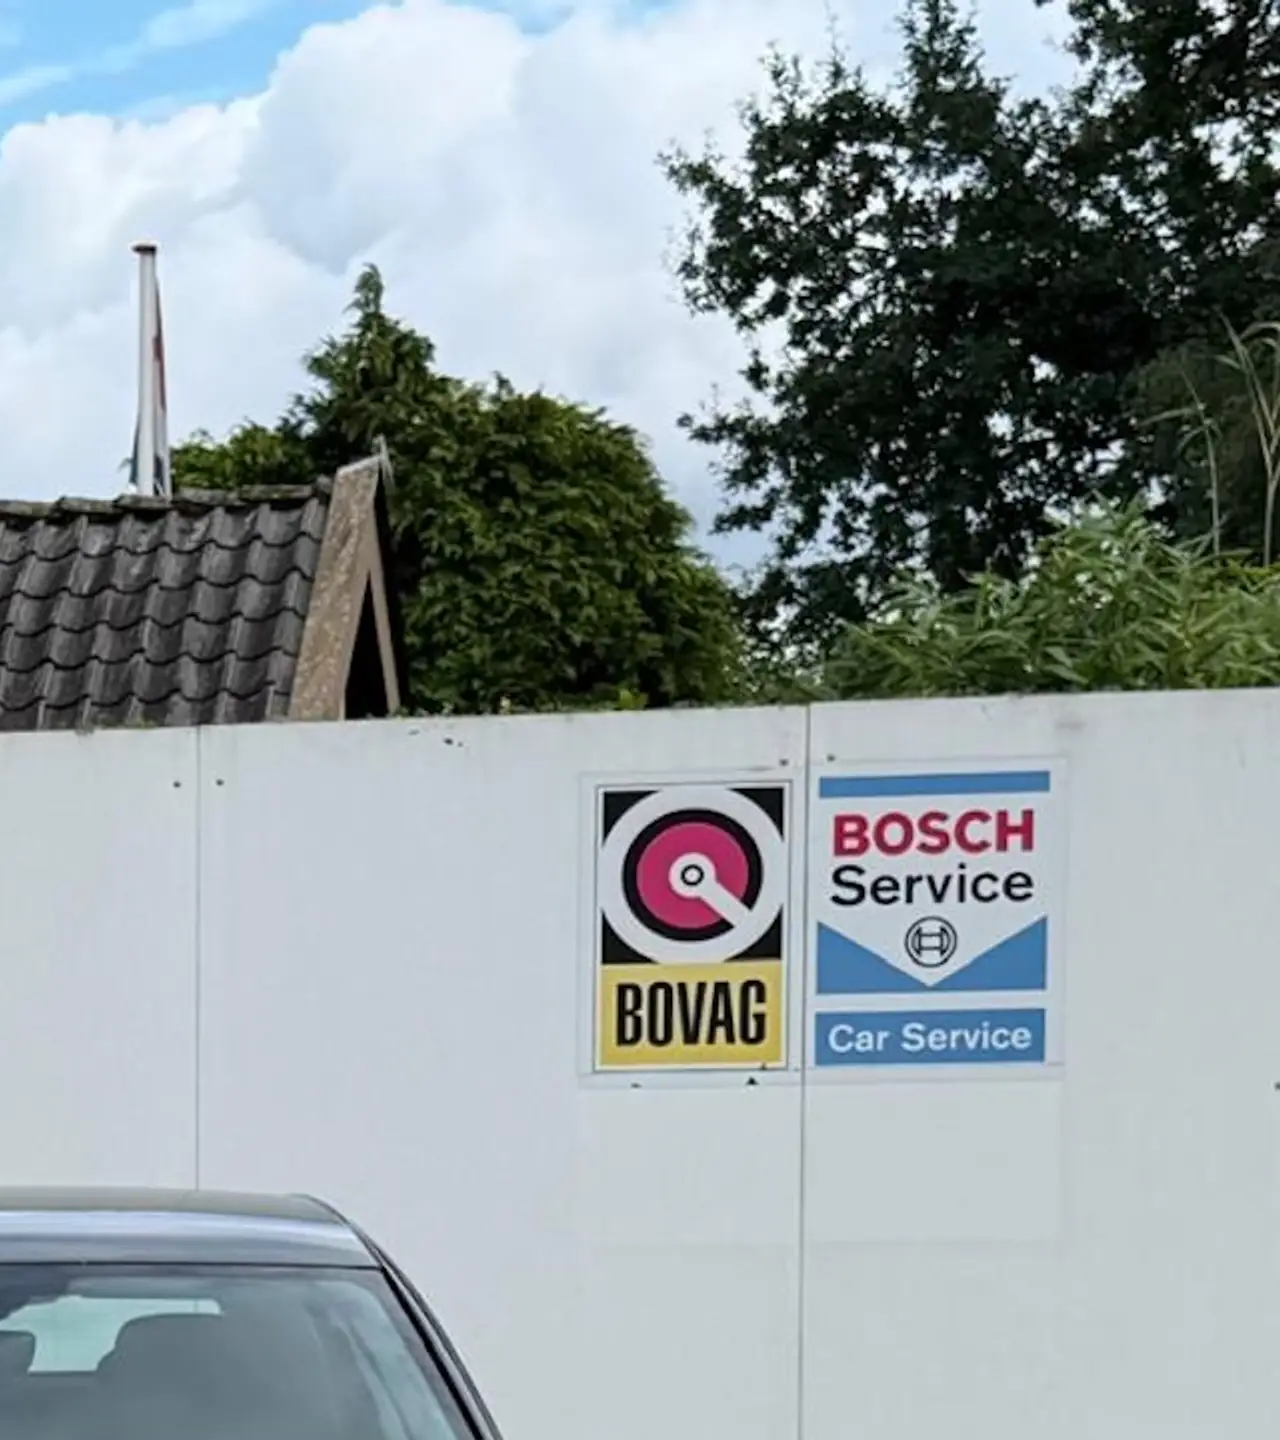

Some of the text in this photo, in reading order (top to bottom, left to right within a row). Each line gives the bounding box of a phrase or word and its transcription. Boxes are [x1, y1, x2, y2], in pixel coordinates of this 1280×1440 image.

[833, 808, 1035, 857] BOSCH
[830, 862, 1035, 906] Service
[615, 979, 767, 1047] BOVAG
[827, 1021, 1032, 1053] Car Service
